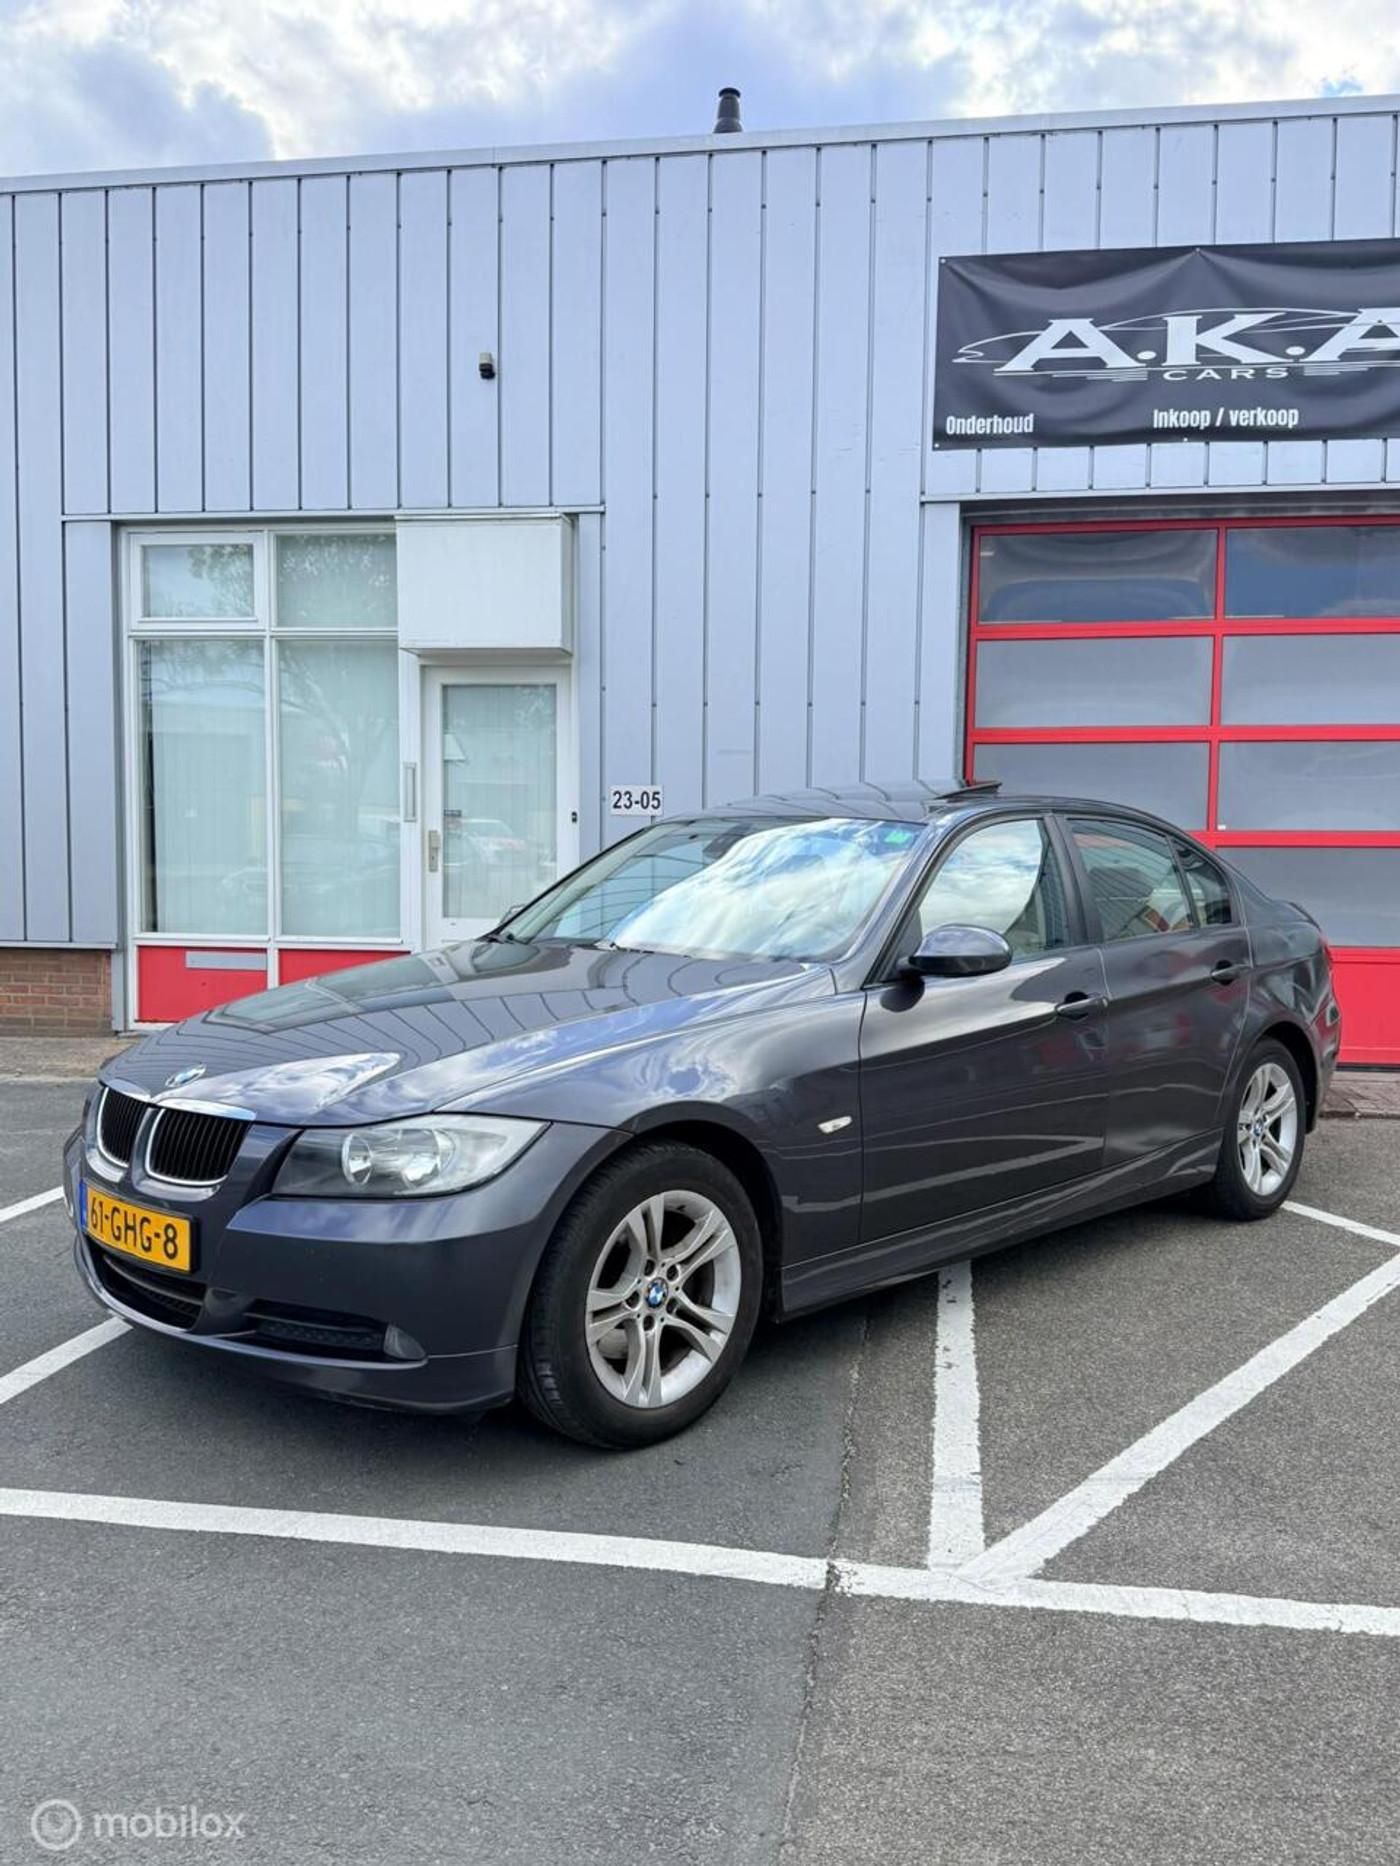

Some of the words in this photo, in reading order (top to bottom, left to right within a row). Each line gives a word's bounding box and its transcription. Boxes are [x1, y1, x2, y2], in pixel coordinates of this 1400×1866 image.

[1163, 367, 1289, 381] CARS
[946, 413, 1034, 435] Onderhoud
[1153, 408, 1211, 429] Inkoop
[1215, 408, 1225, 427] /
[1229, 407, 1299, 428] verkoop
[612, 790, 661, 810] 23-05
[90, 1197, 178, 1260] 61-GHG-8
